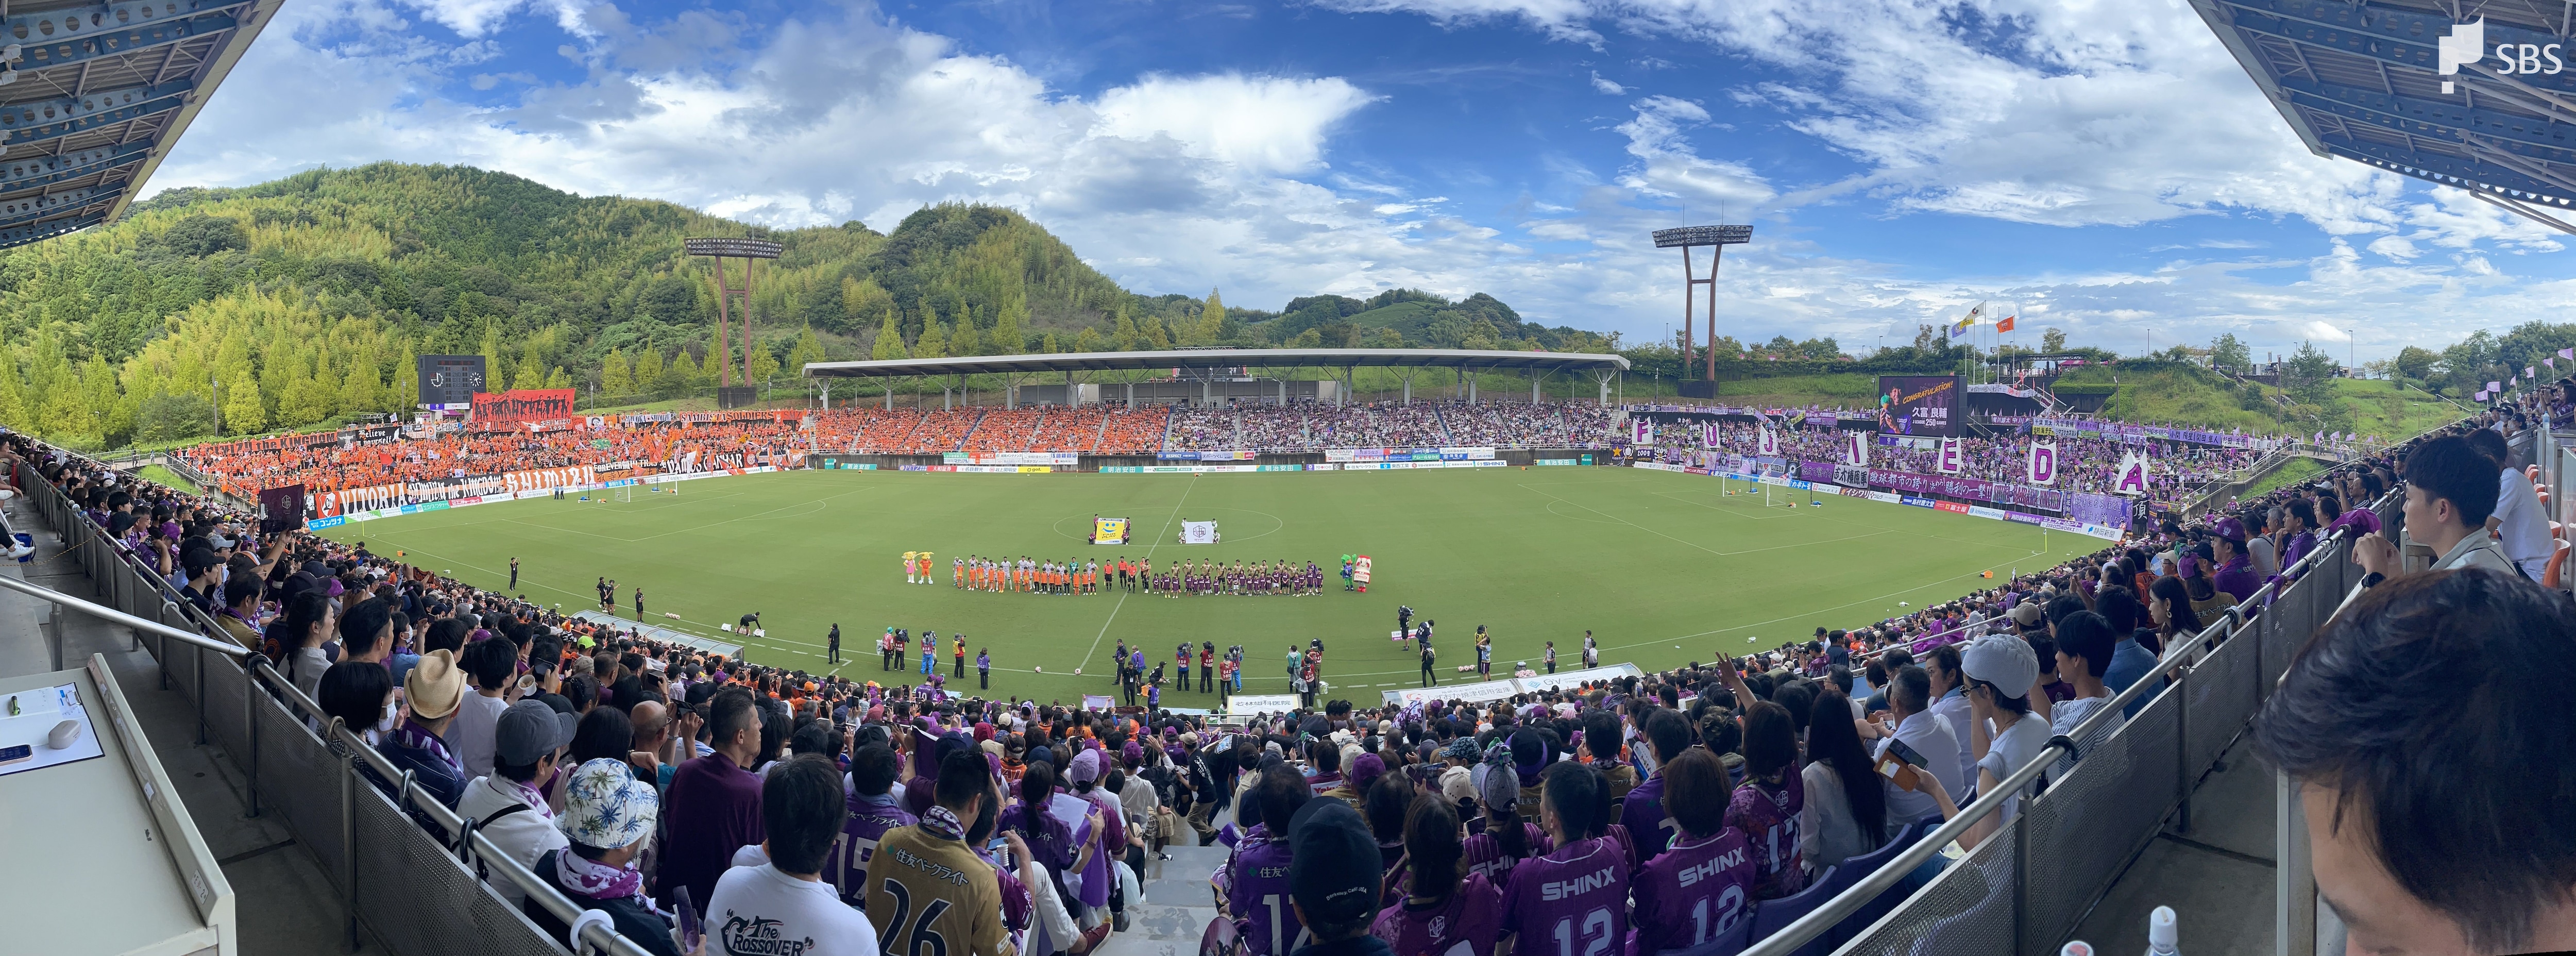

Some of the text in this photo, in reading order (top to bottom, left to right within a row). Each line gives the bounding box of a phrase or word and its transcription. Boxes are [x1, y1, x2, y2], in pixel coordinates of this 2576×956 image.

[1903, 381, 1953, 405] CONGRATULATION!
[681, 412, 774, 422] SAMBISTA SOLDIERS
[1912, 407, 1947, 418] 久富 良輔
[490, 420, 520, 432] ULTRAS
[540, 418, 571, 427] SHIMIZU
[1637, 421, 1649, 442] F
[256, 432, 335, 450] the KINGDOM
[358, 429, 386, 439] Believe
[1706, 425, 1718, 446] U
[1764, 433, 1773, 452] J
[1943, 440, 1957, 472] E
[2035, 447, 2053, 481] D
[594, 461, 623, 473] FOREVER
[461, 475, 502, 498] KINGDOM
[503, 465, 596, 495] SHIMIZU
[1791, 480, 1811, 490] カネトモ
[1869, 472, 1928, 489] 蹴球都市の誇り
[2119, 462, 2143, 492] A
[338, 482, 409, 515] VITORIA
[1846, 488, 1869, 498] イシワリ
[1950, 505, 1968, 513] 富士屋
[1974, 508, 1991, 516] Ichimaru
[2133, 500, 2148, 520] 頂
[319, 517, 342, 527] コンツナ
[2010, 514, 2036, 524] 消防設備保全
[2047, 518, 2081, 527] ユニフォームセンター
[2093, 527, 2115, 539] 静岡新聞
[1428, 686, 1511, 700] しずおか焼津信用金庫
[837, 831, 879, 901] 15
[895, 848, 969, 887] 住友ベークライト
[1678, 846, 1746, 888] SHINX
[1541, 865, 1616, 901] SHINX
[877, 877, 954, 956] 26
[1690, 882, 1745, 947] 12
[1553, 904, 1614, 956] 12
